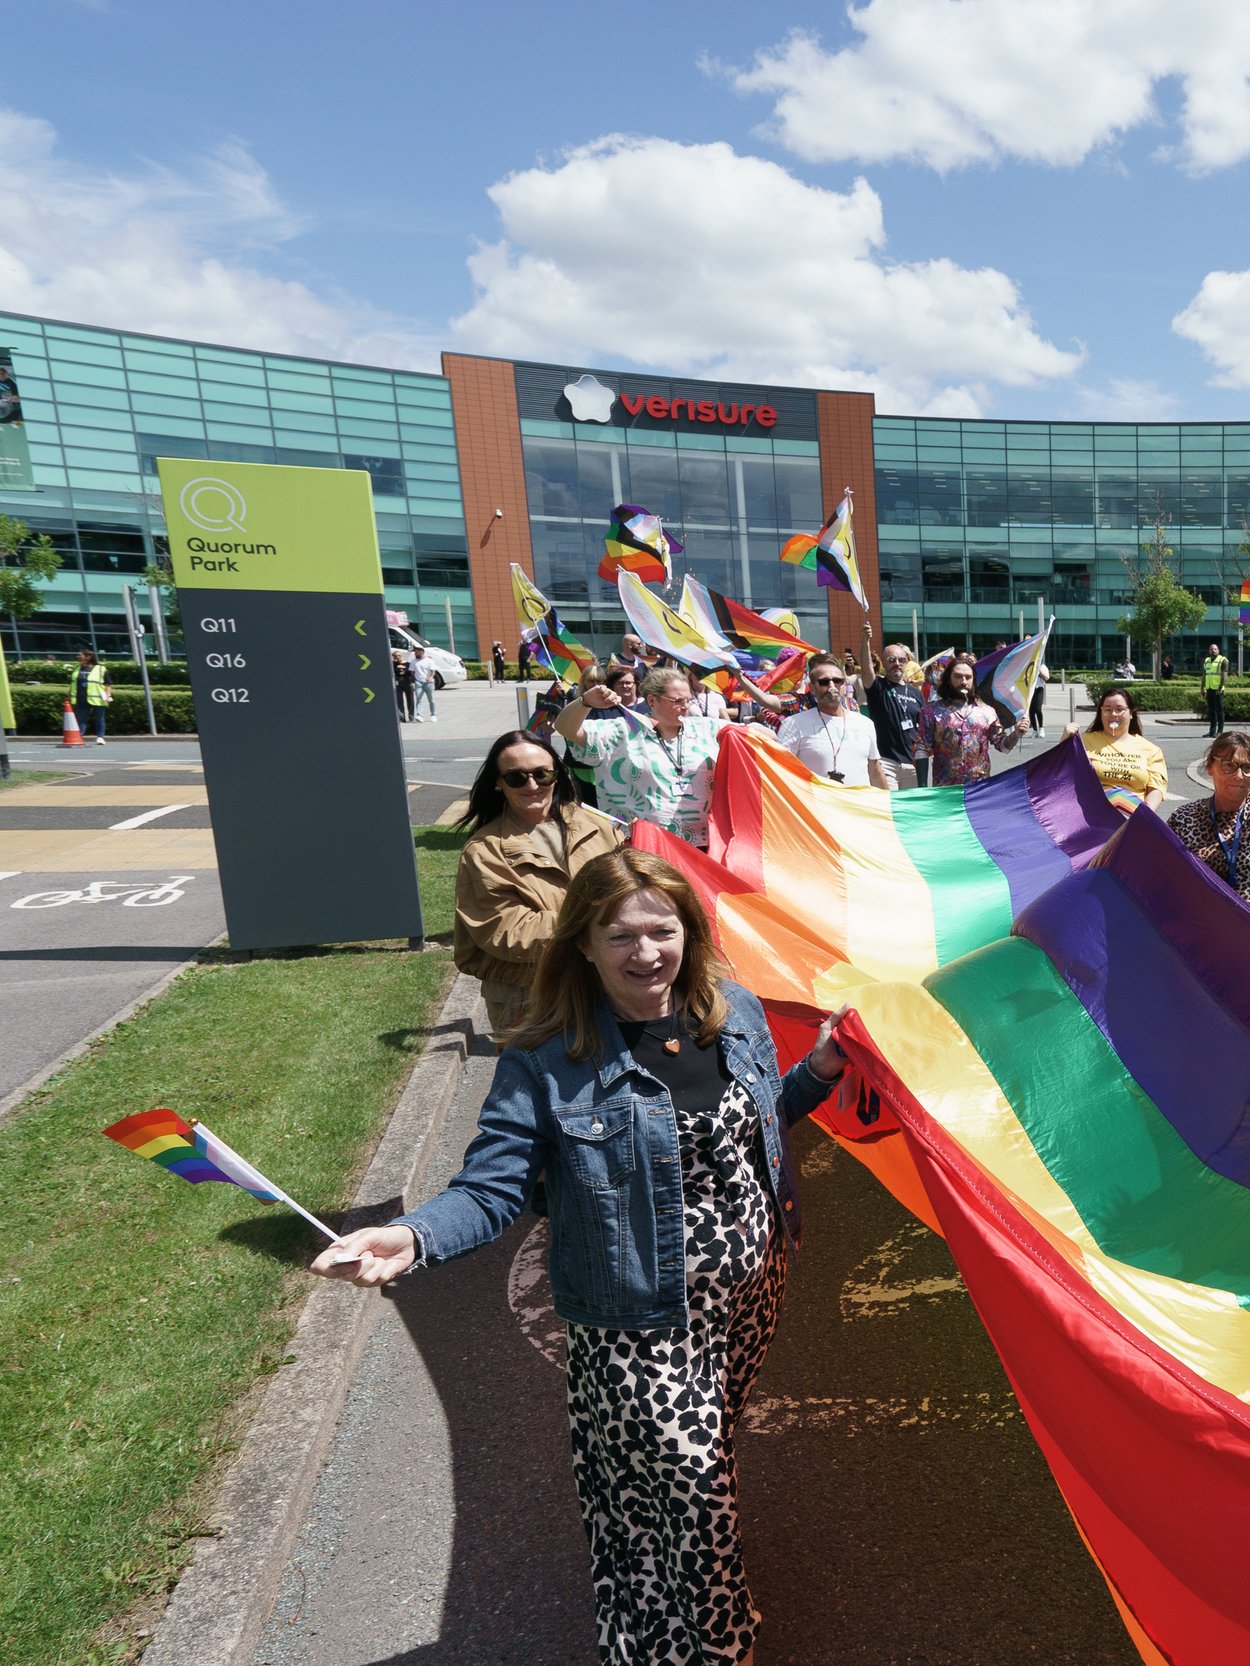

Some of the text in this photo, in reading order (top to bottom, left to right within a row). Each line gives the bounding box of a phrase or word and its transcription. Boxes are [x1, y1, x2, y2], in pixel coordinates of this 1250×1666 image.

[620, 393, 778, 427] verisure
[187, 537, 277, 556] Quorum
[190, 556, 240, 573] Park
[200, 617, 237, 634] Q11
[205, 652, 247, 670] Q16
[211, 687, 250, 704] Q12
[1104, 771, 1119, 779] THE
